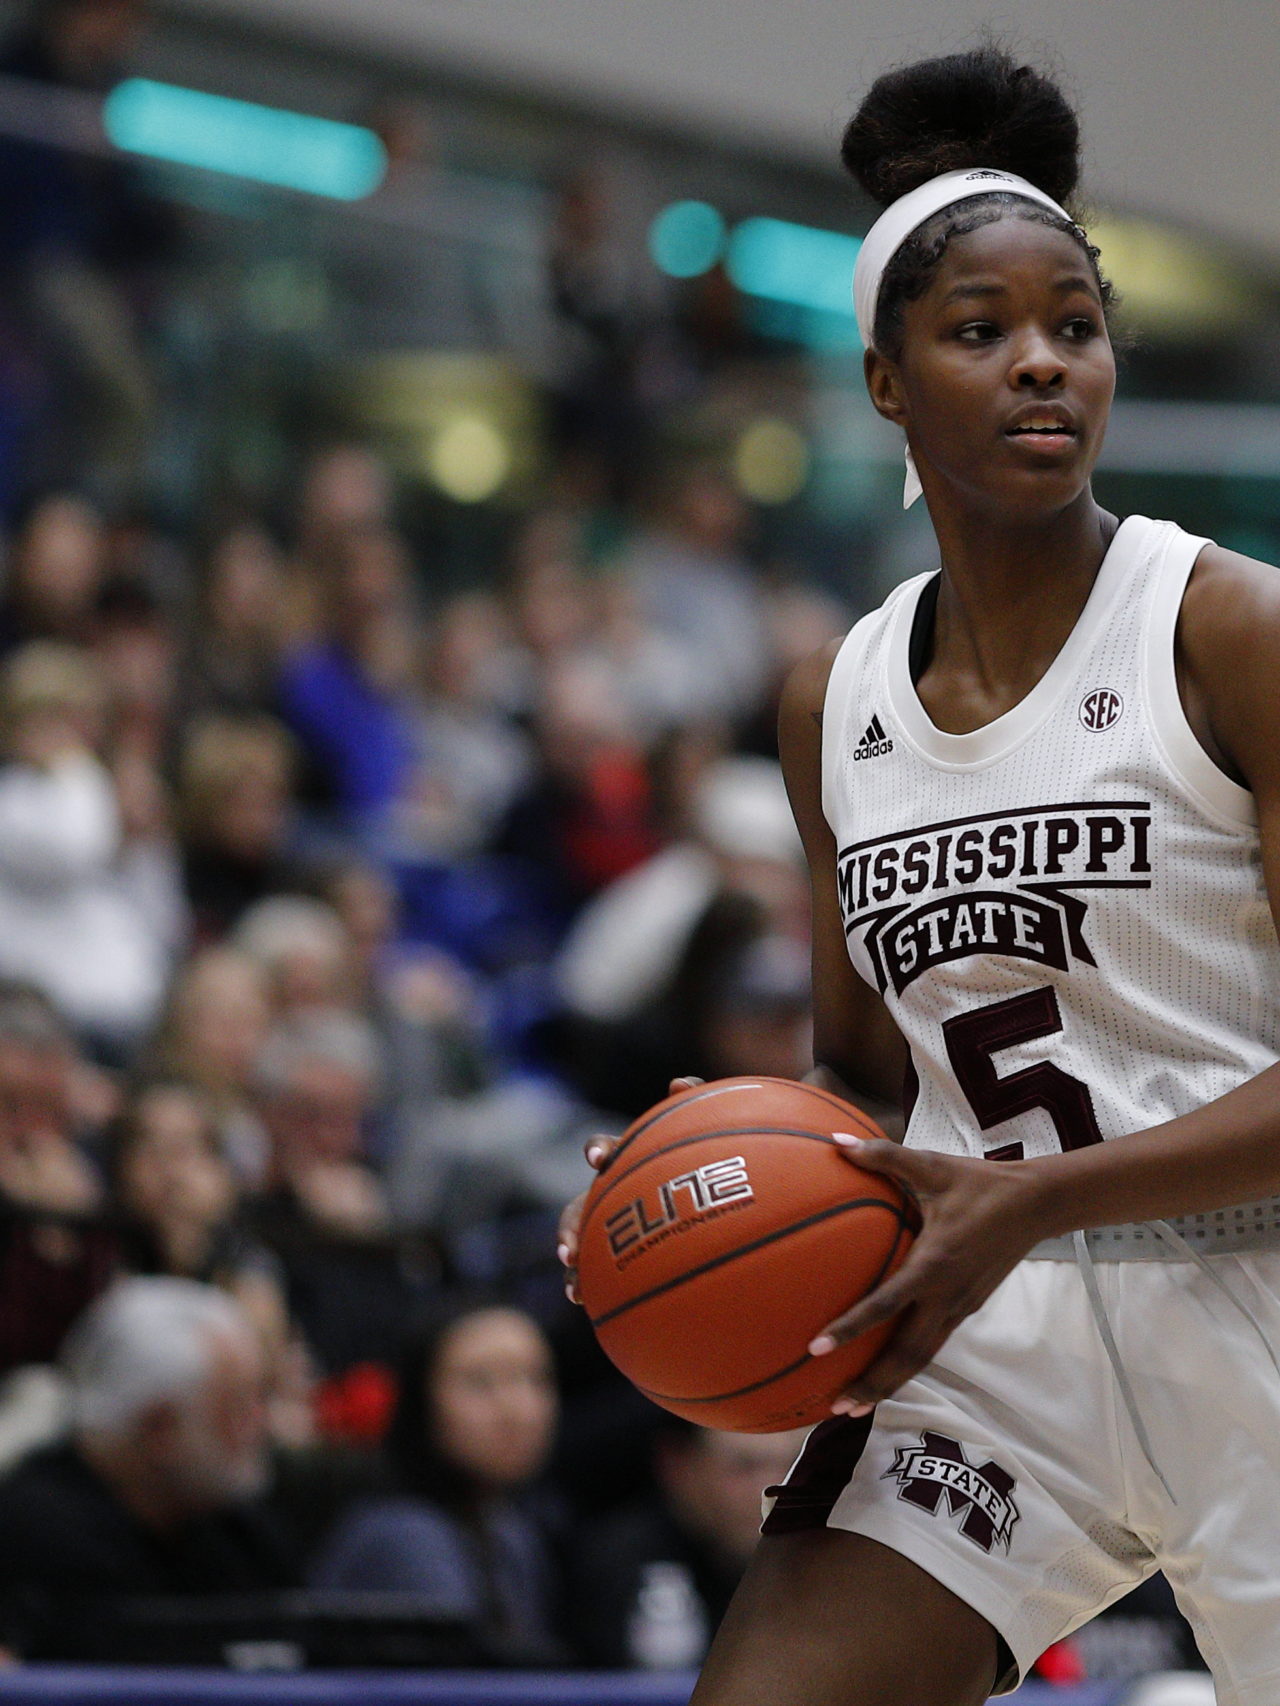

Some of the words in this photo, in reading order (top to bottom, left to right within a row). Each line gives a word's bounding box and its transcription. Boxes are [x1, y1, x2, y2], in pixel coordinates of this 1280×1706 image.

[1084, 691, 1119, 729] SEC
[853, 740, 893, 761] adidas
[838, 816, 1151, 922] MISSISSIPPI
[895, 902, 1044, 973] STATE
[941, 985, 1105, 1161] 5
[605, 1155, 754, 1257] ELITE
[615, 1199, 755, 1271] CHAMPIONSHIP
[917, 1458, 1002, 1520] STATE
